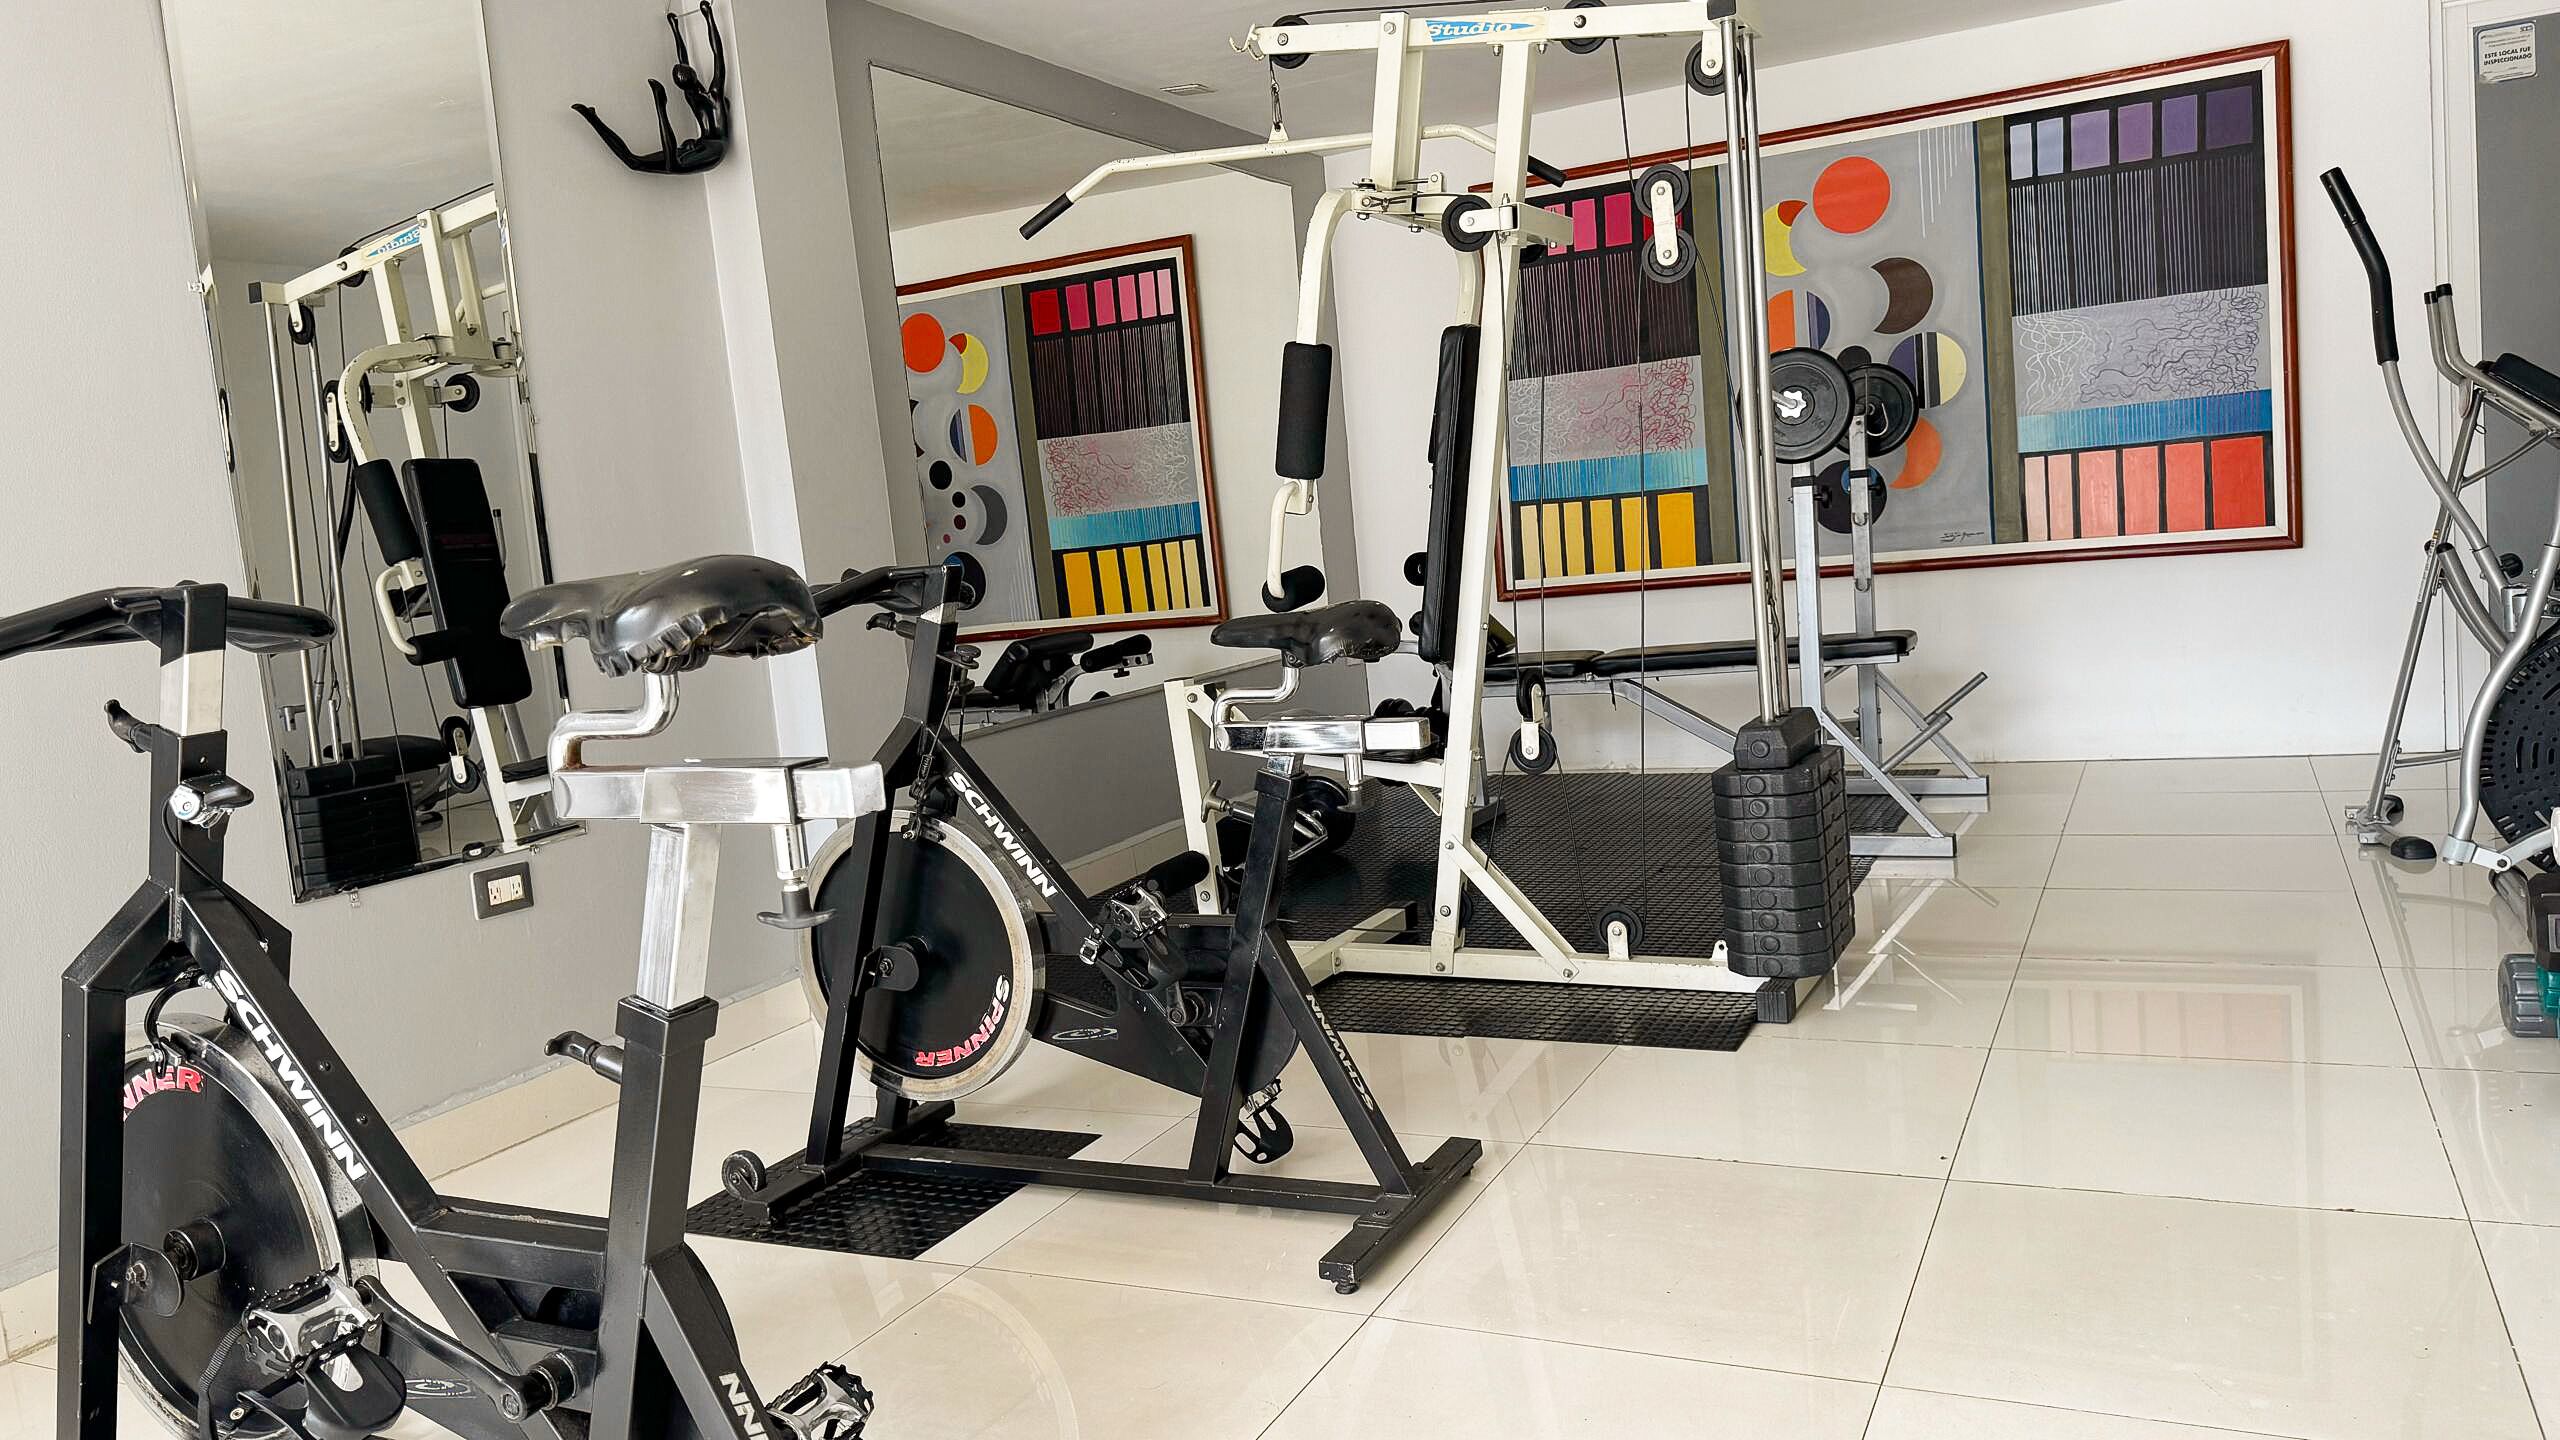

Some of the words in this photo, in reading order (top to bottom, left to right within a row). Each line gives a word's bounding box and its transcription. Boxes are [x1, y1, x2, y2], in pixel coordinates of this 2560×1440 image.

[1428, 22, 1512, 36] Studio
[2483, 53, 2533, 66] INSPECCIONADO
[2484, 51, 2498, 59] ESTE
[2499, 48, 2519, 57] LOCAL
[2520, 46, 2531, 54] FUE
[947, 771, 1059, 897] SCHWINN
[914, 974, 1010, 1067] SPINNER
[1305, 994, 1374, 1111] SCHWINN
[123, 1065, 202, 1121] NNER
[213, 969, 368, 1181] SCHWINN
